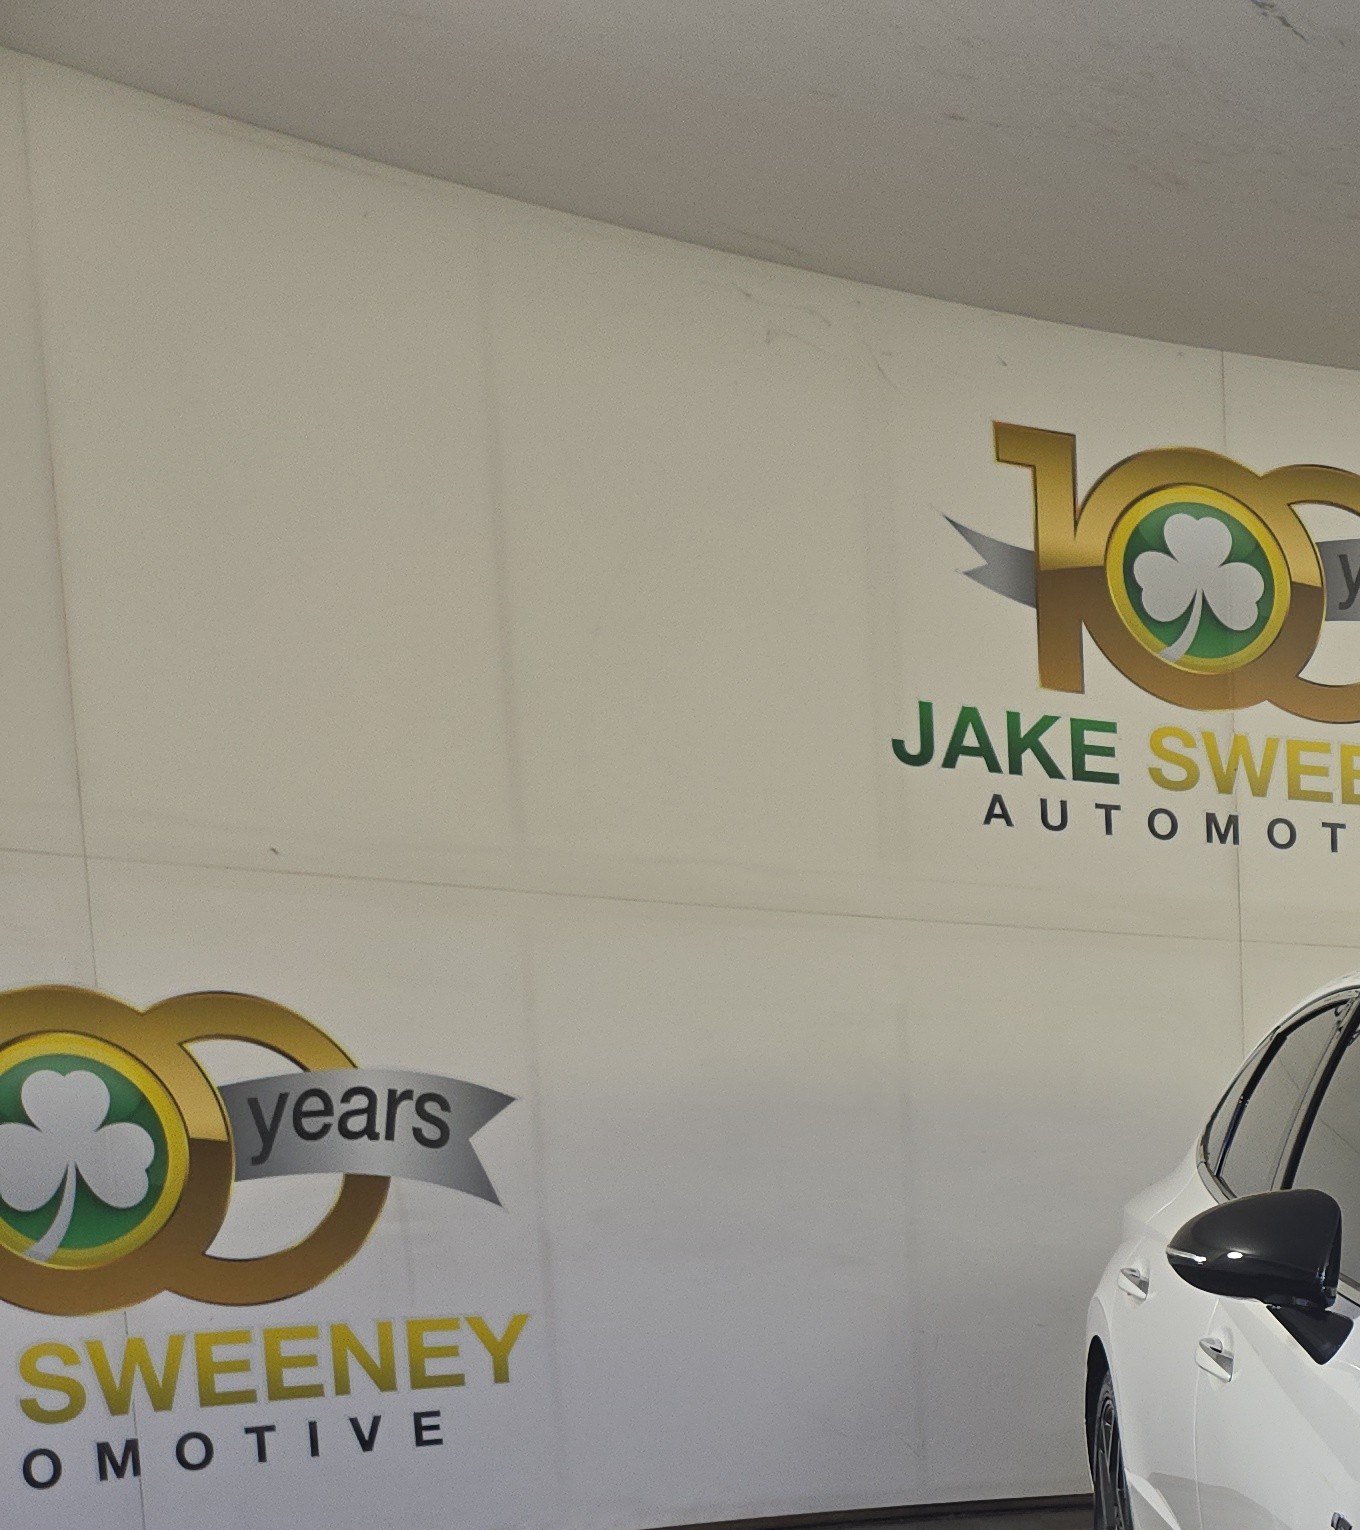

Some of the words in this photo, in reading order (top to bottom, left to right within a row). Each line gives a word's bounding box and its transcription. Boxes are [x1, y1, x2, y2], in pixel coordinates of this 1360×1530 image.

[890, 699, 1121, 785] JAKE
[246, 1084, 452, 1166] years
[18, 1313, 530, 1425] SWEENEY
